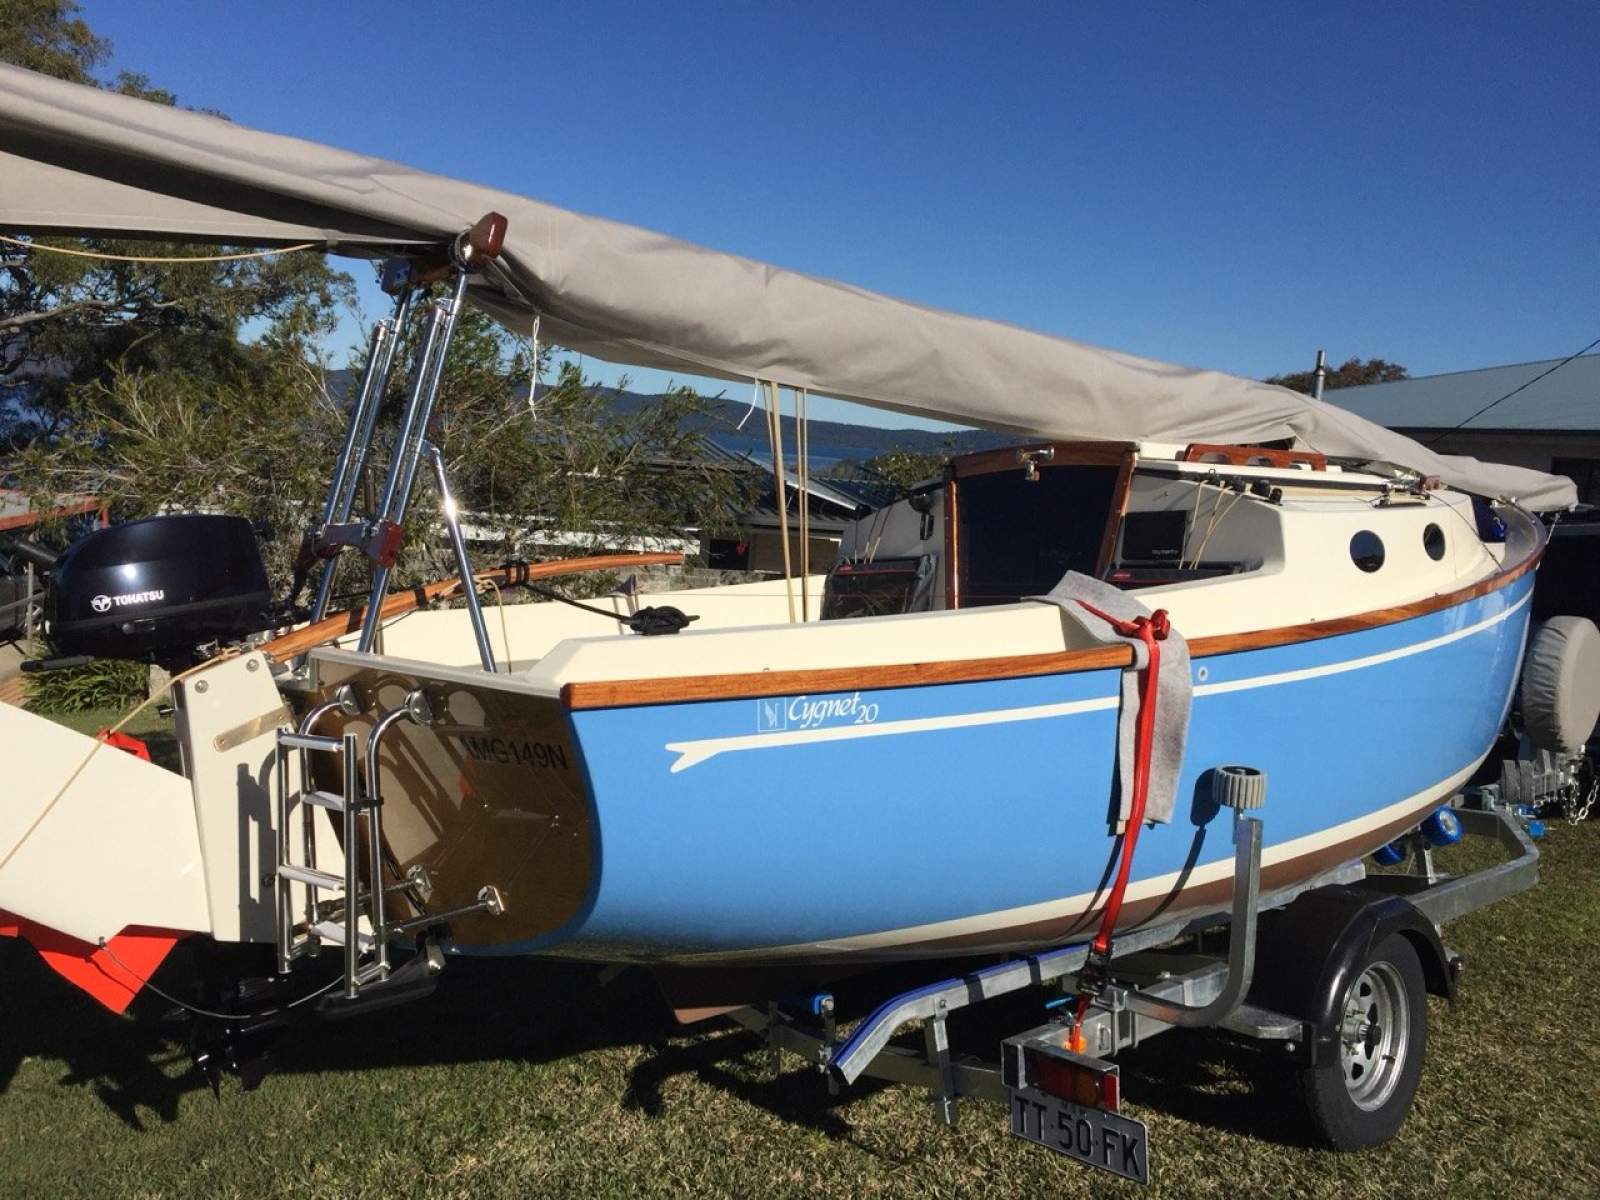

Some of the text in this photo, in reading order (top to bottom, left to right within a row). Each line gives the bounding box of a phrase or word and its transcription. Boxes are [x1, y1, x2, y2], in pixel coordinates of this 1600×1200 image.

[112, 590, 165, 606] TOHATSU
[788, 692, 879, 729] Cygnet 20
